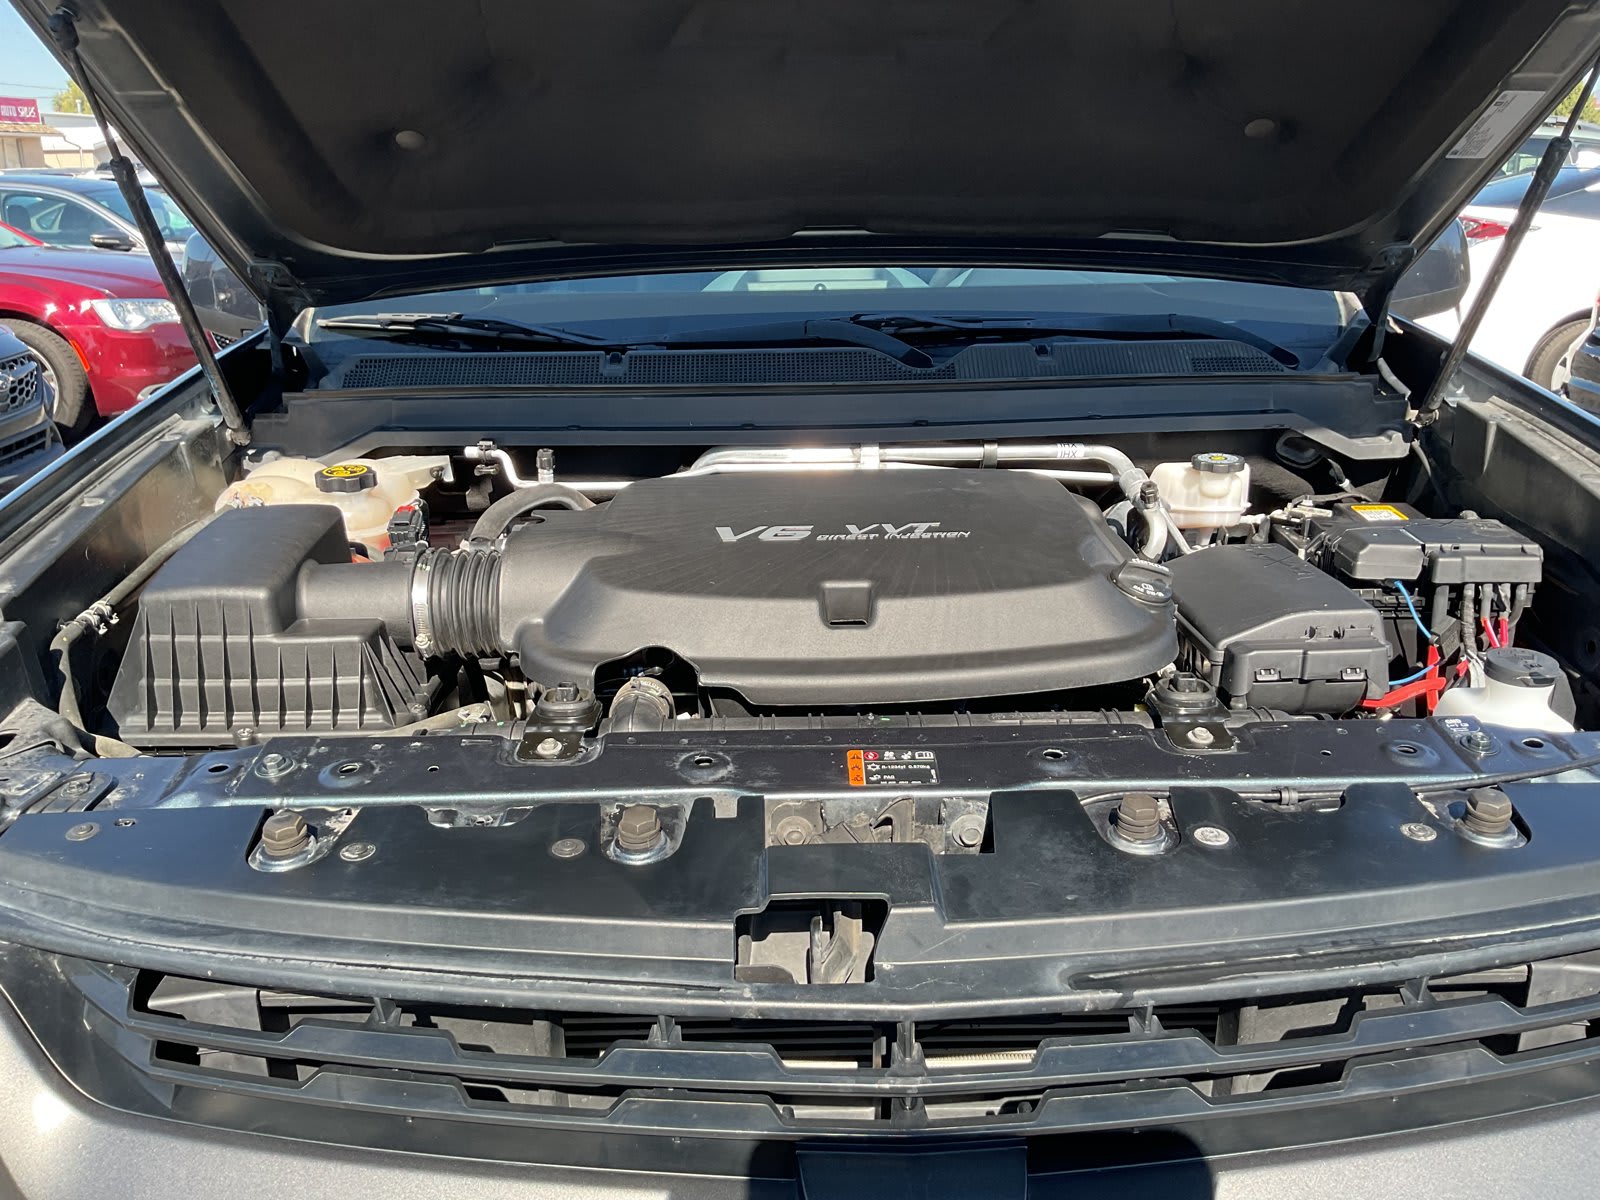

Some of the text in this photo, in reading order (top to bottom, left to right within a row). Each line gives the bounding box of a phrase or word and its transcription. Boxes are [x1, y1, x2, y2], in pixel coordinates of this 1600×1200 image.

[716, 525, 814, 542] V6
[845, 522, 941, 534] VVT
[884, 531, 971, 540] INJECTION
